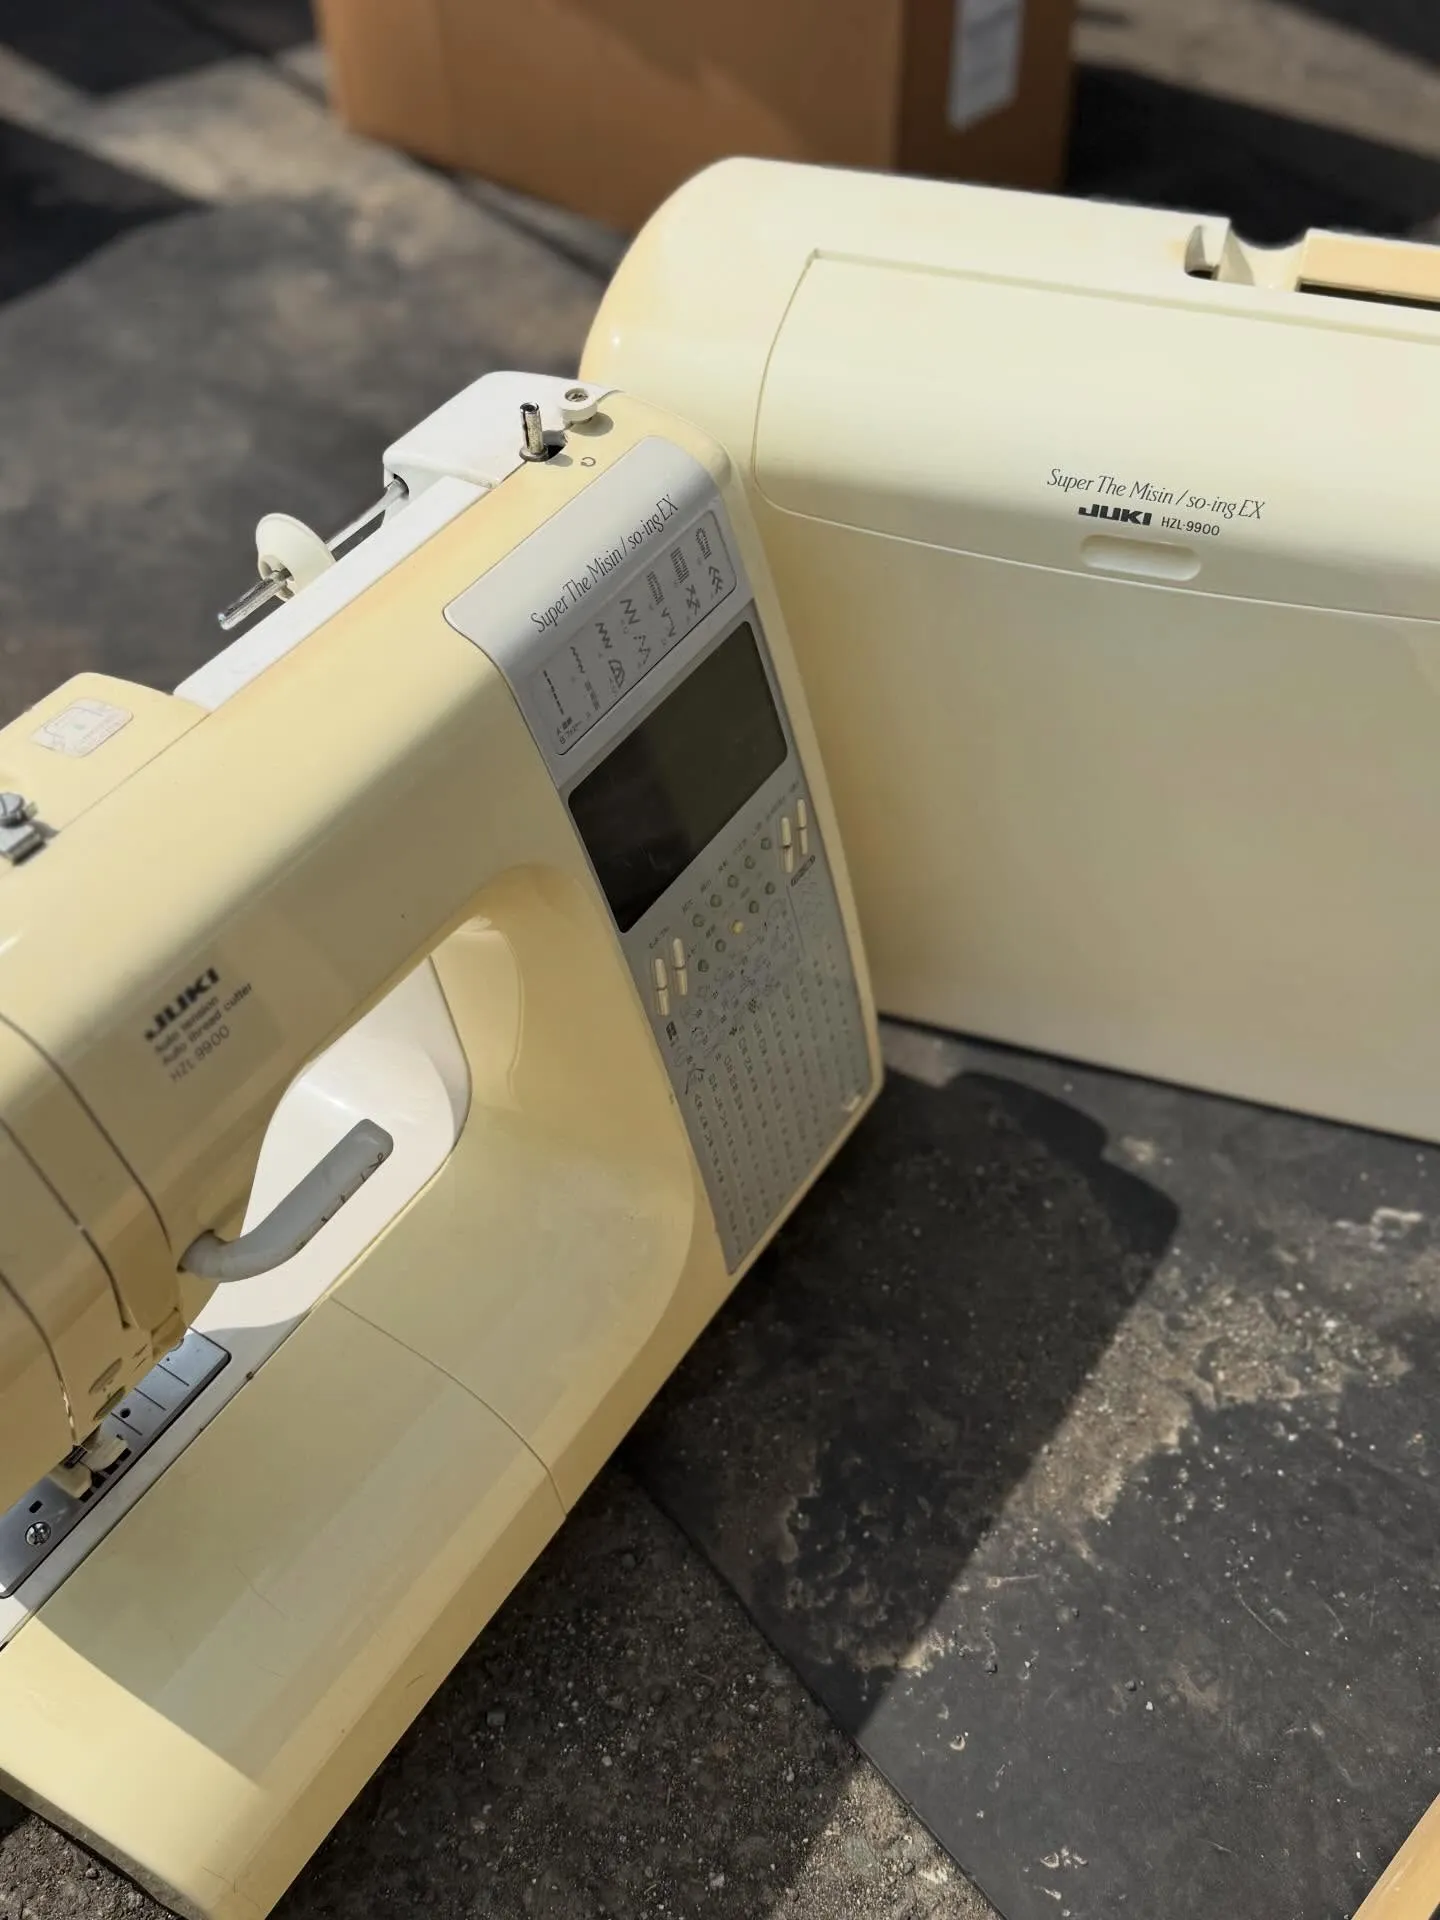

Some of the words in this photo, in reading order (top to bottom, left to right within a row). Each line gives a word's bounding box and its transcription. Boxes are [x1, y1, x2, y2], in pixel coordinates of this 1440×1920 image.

[1047, 468, 1095, 493] Super
[1097, 475, 1127, 497] The
[1128, 481, 1174, 506] Misin
[1238, 499, 1266, 520] EX
[1078, 503, 1153, 526] JUKI
[1161, 516, 1221, 537] HZL-9900
[530, 595, 569, 633] Super
[562, 578, 592, 603] The
[586, 548, 623, 584] Misin
[656, 494, 679, 522] EX
[144, 967, 219, 1042] JUKI
[223, 982, 252, 1012] cutter
